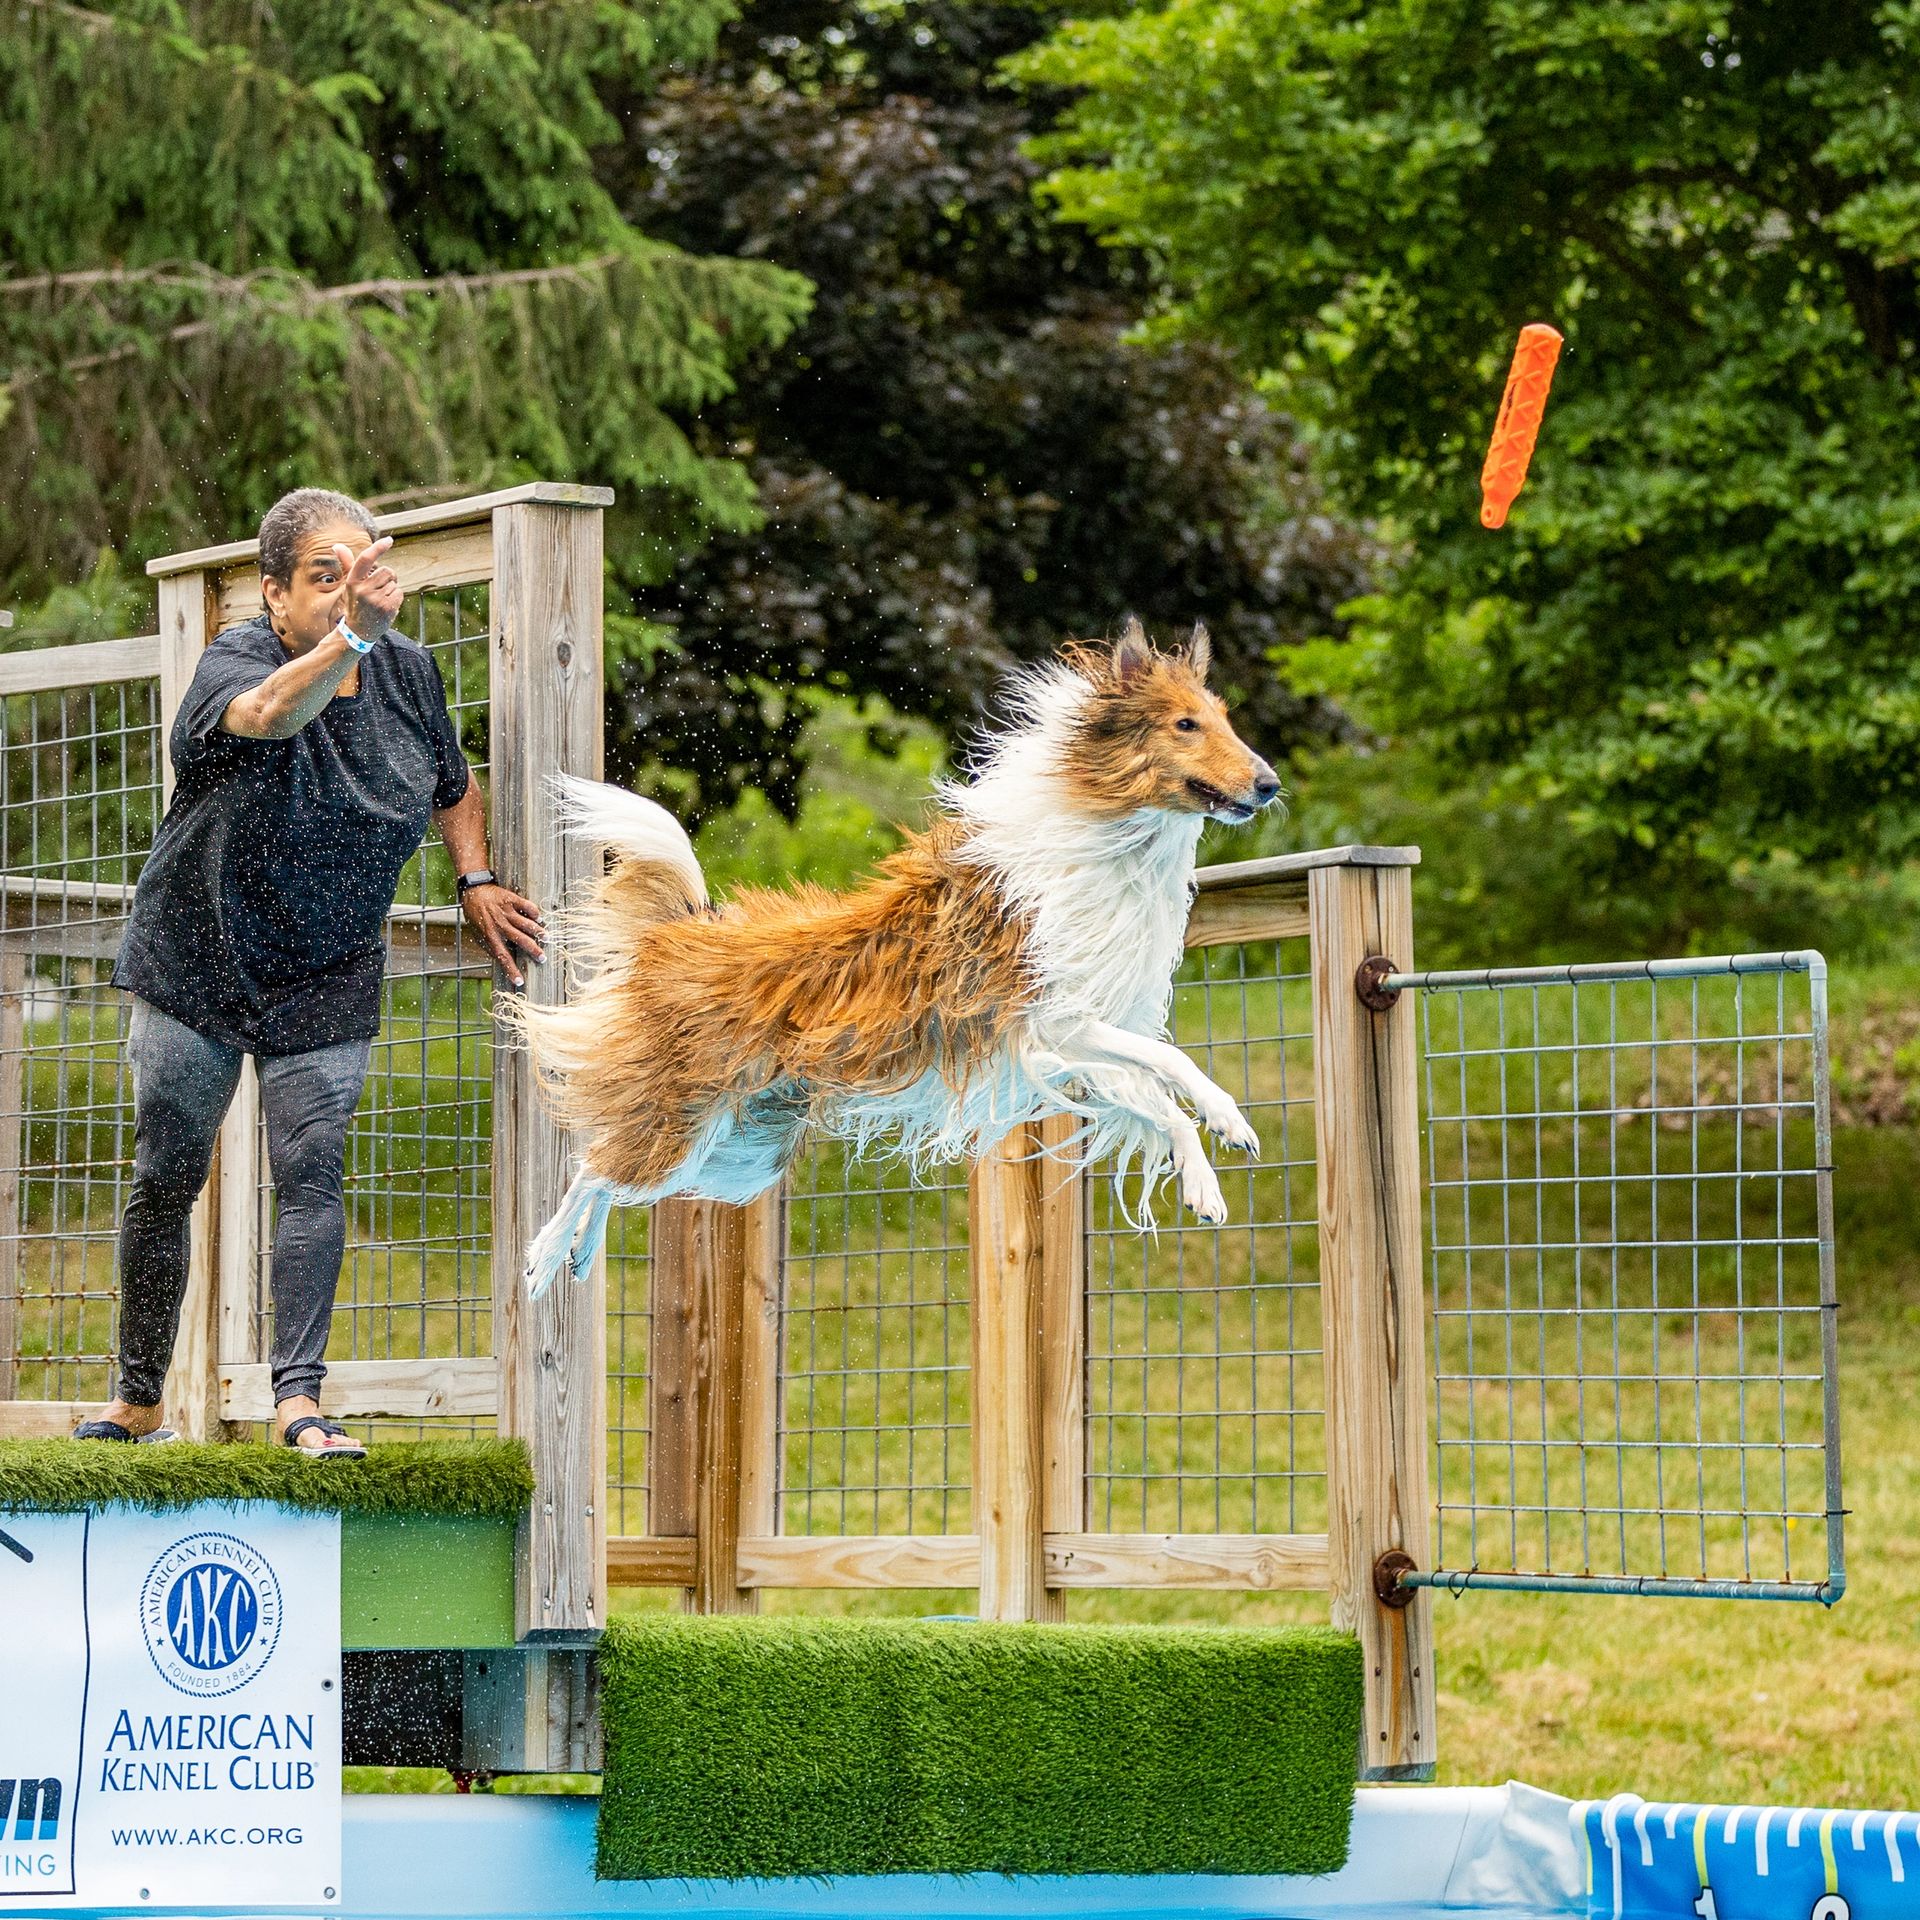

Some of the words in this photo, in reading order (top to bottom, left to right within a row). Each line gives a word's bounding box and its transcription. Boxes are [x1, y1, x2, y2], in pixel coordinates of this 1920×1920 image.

[148, 1544, 197, 1628] AMERICAN
[201, 1541, 261, 1580] KENNEL
[258, 1579, 274, 1627] CLUB
[171, 1566, 252, 1668] AKC
[167, 1661, 221, 1689] FOUNDED
[225, 1661, 252, 1684] 1884
[105, 1709, 314, 1752] AMERICAN
[99, 1757, 218, 1792] KENNEL
[228, 1755, 315, 1791] CLUB
[111, 1827, 304, 1846] WWW.AKC.ORG
[0, 1854, 56, 1876] ING
